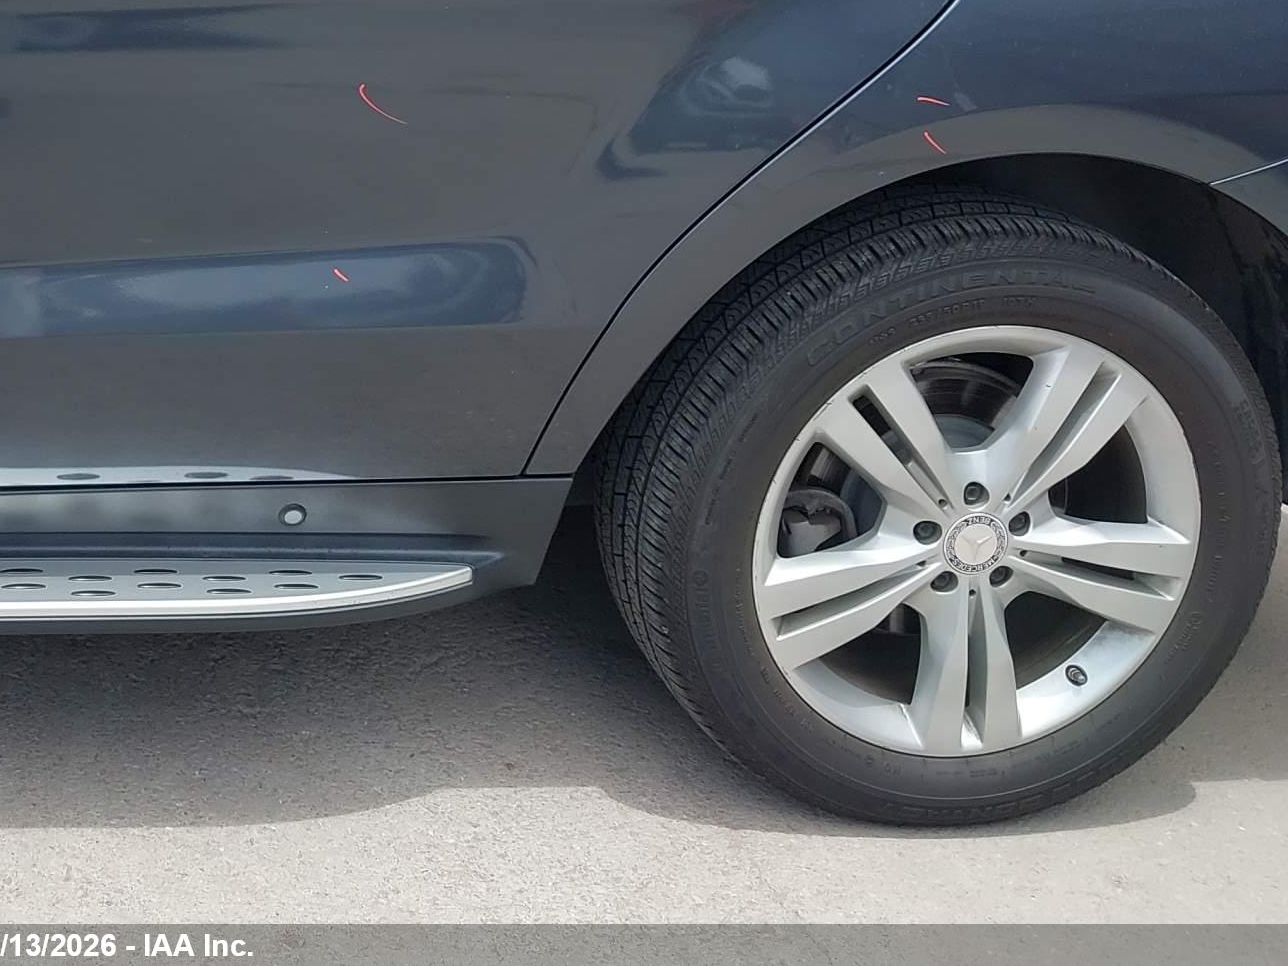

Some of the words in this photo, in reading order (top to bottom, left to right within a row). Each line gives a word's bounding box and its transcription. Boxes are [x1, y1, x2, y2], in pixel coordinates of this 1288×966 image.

[807, 267, 1097, 367] CONTINENTAL
[966, 516, 992, 525] BENZ
[951, 555, 997, 571] MERCEDES
